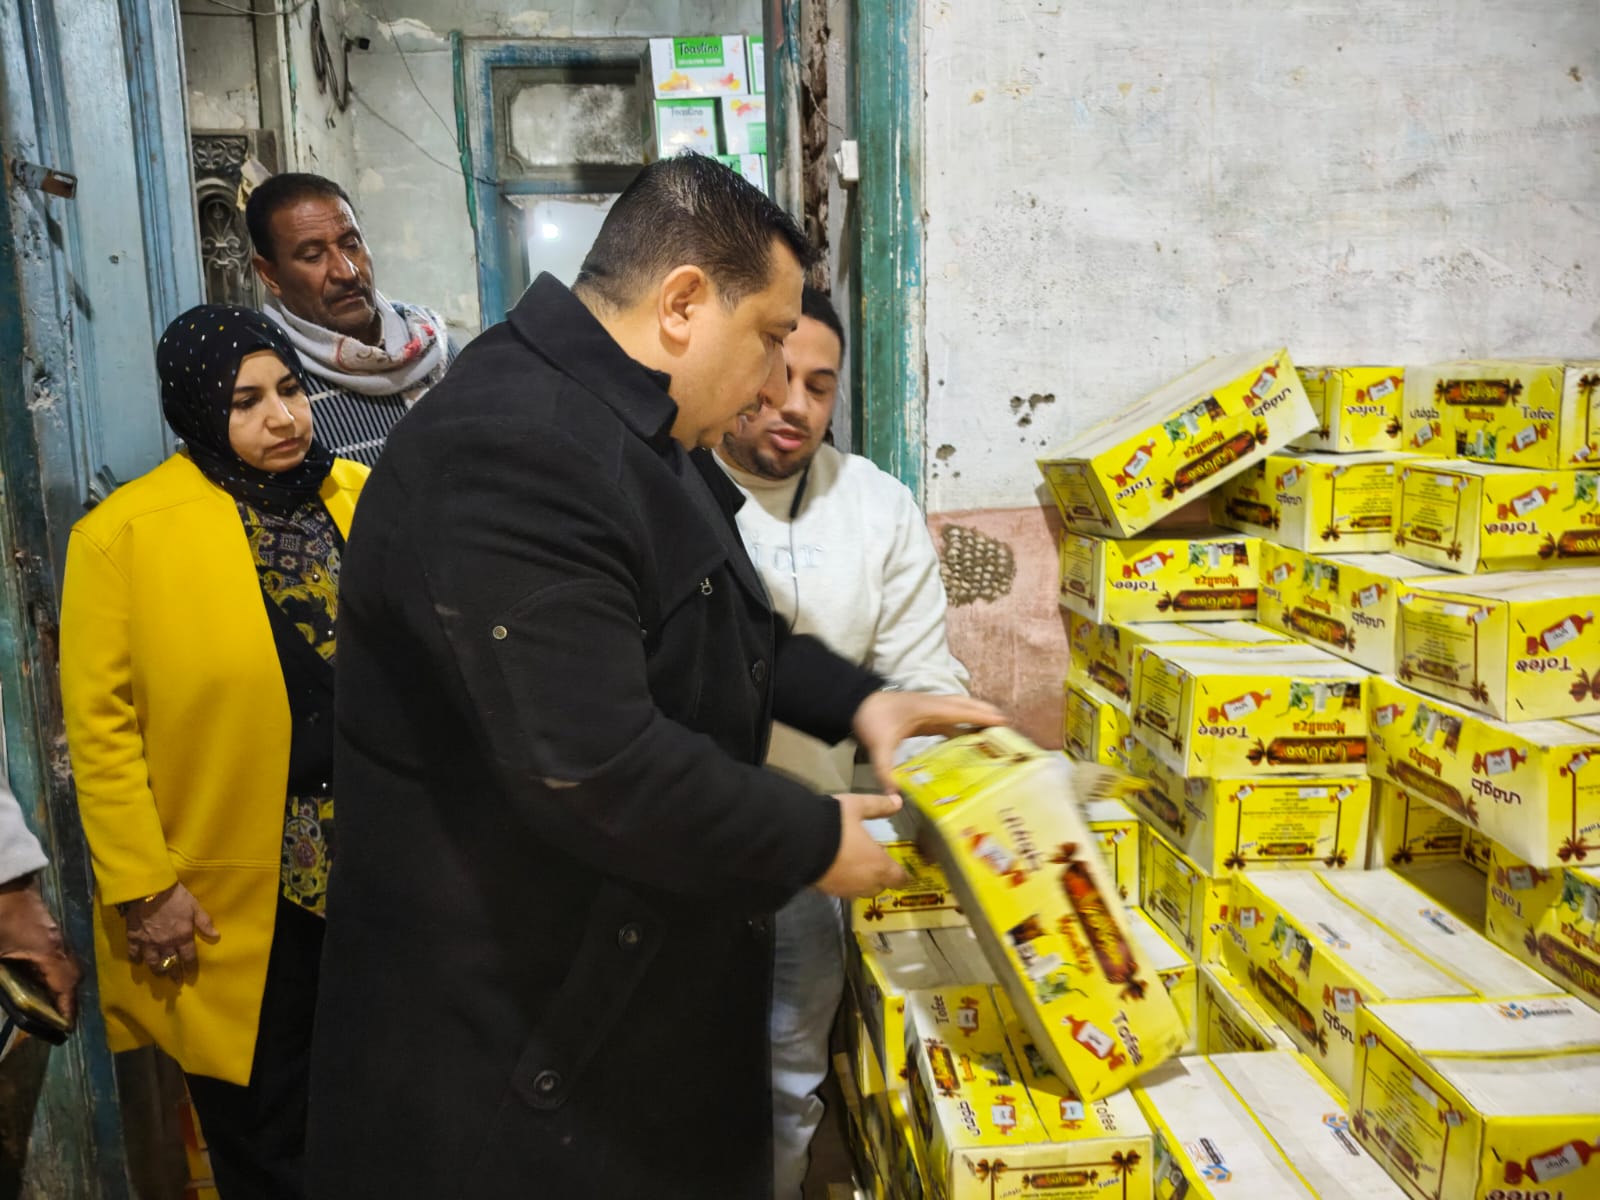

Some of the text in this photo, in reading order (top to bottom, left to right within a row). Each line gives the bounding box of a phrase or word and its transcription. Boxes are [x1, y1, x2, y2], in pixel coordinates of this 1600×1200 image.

[1347, 405, 1388, 417] Tofee
[1521, 406, 1555, 420] Tofee
[1115, 476, 1157, 501] Tofee
[1485, 520, 1539, 535] Tofee
[1113, 579, 1159, 592] Tofee
[1515, 657, 1573, 673] Tofee
[1197, 724, 1250, 739] Tofee
[1471, 777, 1522, 806] طوفى
